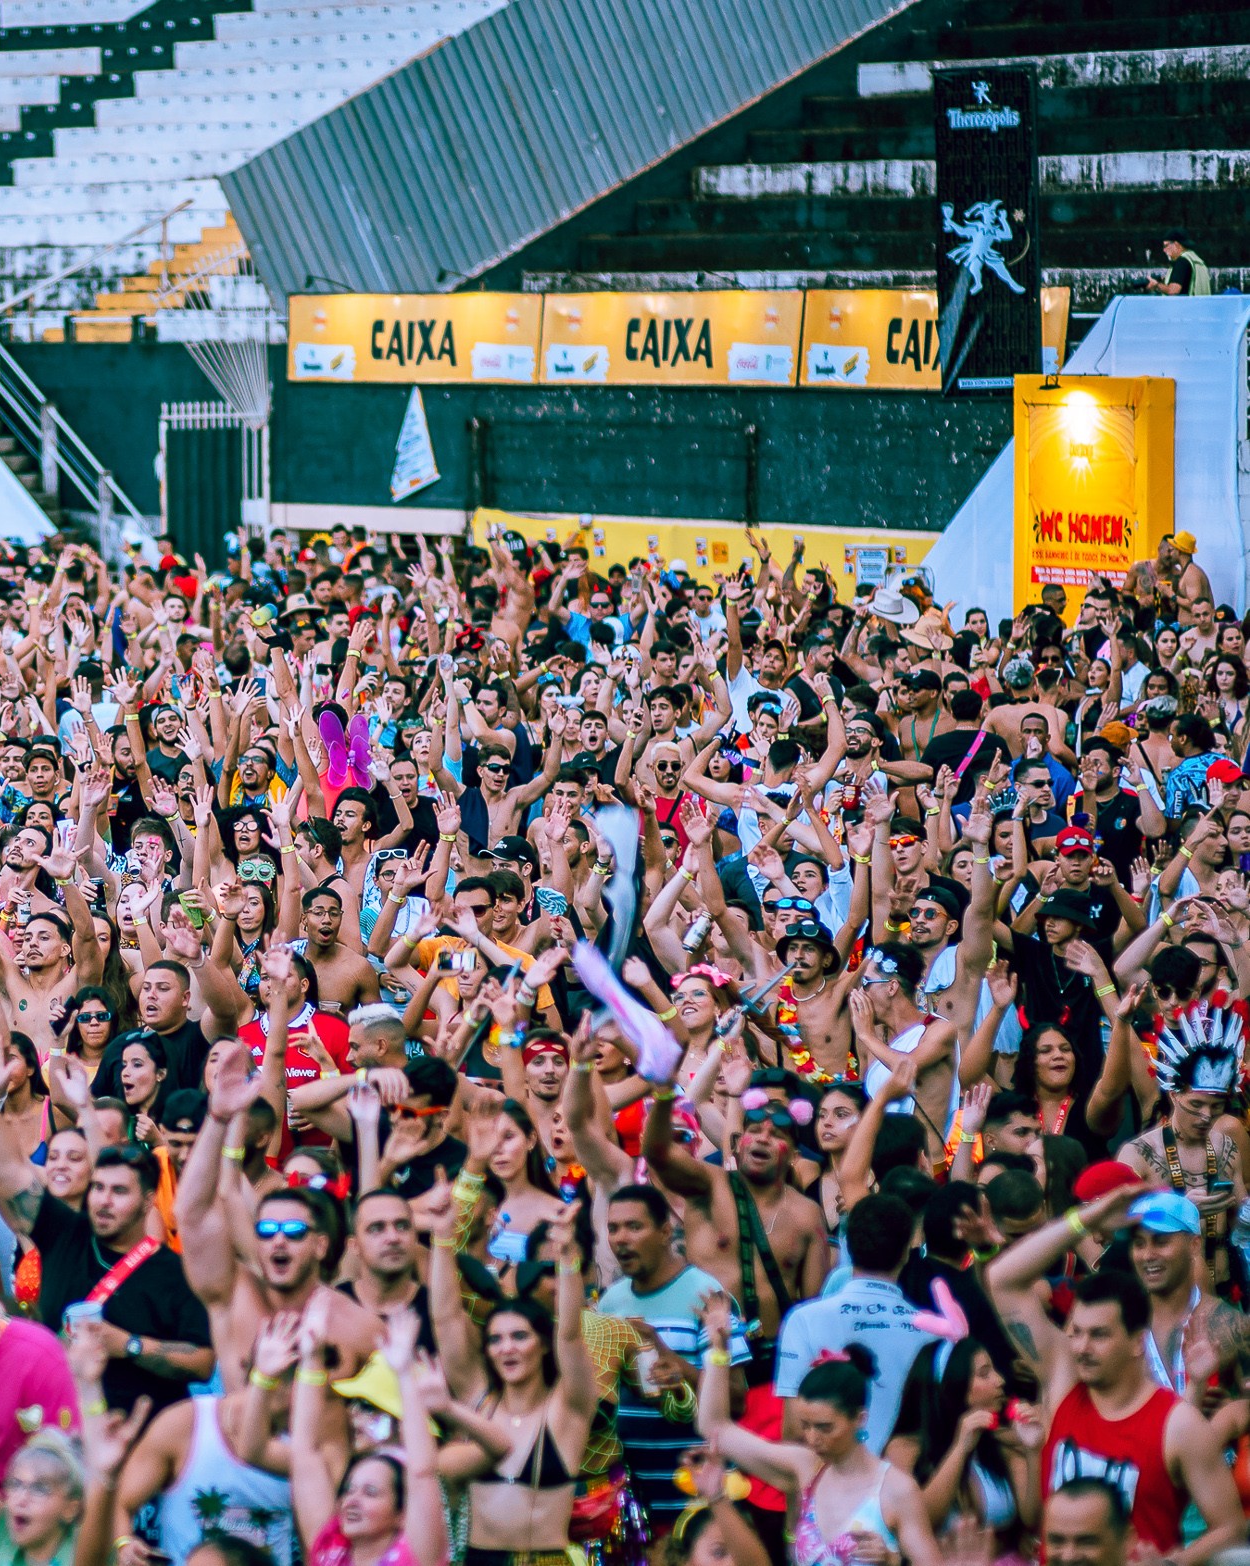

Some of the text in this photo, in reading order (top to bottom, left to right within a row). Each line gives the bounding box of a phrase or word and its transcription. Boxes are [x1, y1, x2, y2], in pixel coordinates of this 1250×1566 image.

[371, 319, 457, 367] CAIXA
[625, 318, 713, 369] CAIXA
[1040, 510, 1123, 546] WC HOMEM
[285, 1067, 316, 1078] Viewer
[1166, 1145, 1185, 1188] DIREITO
